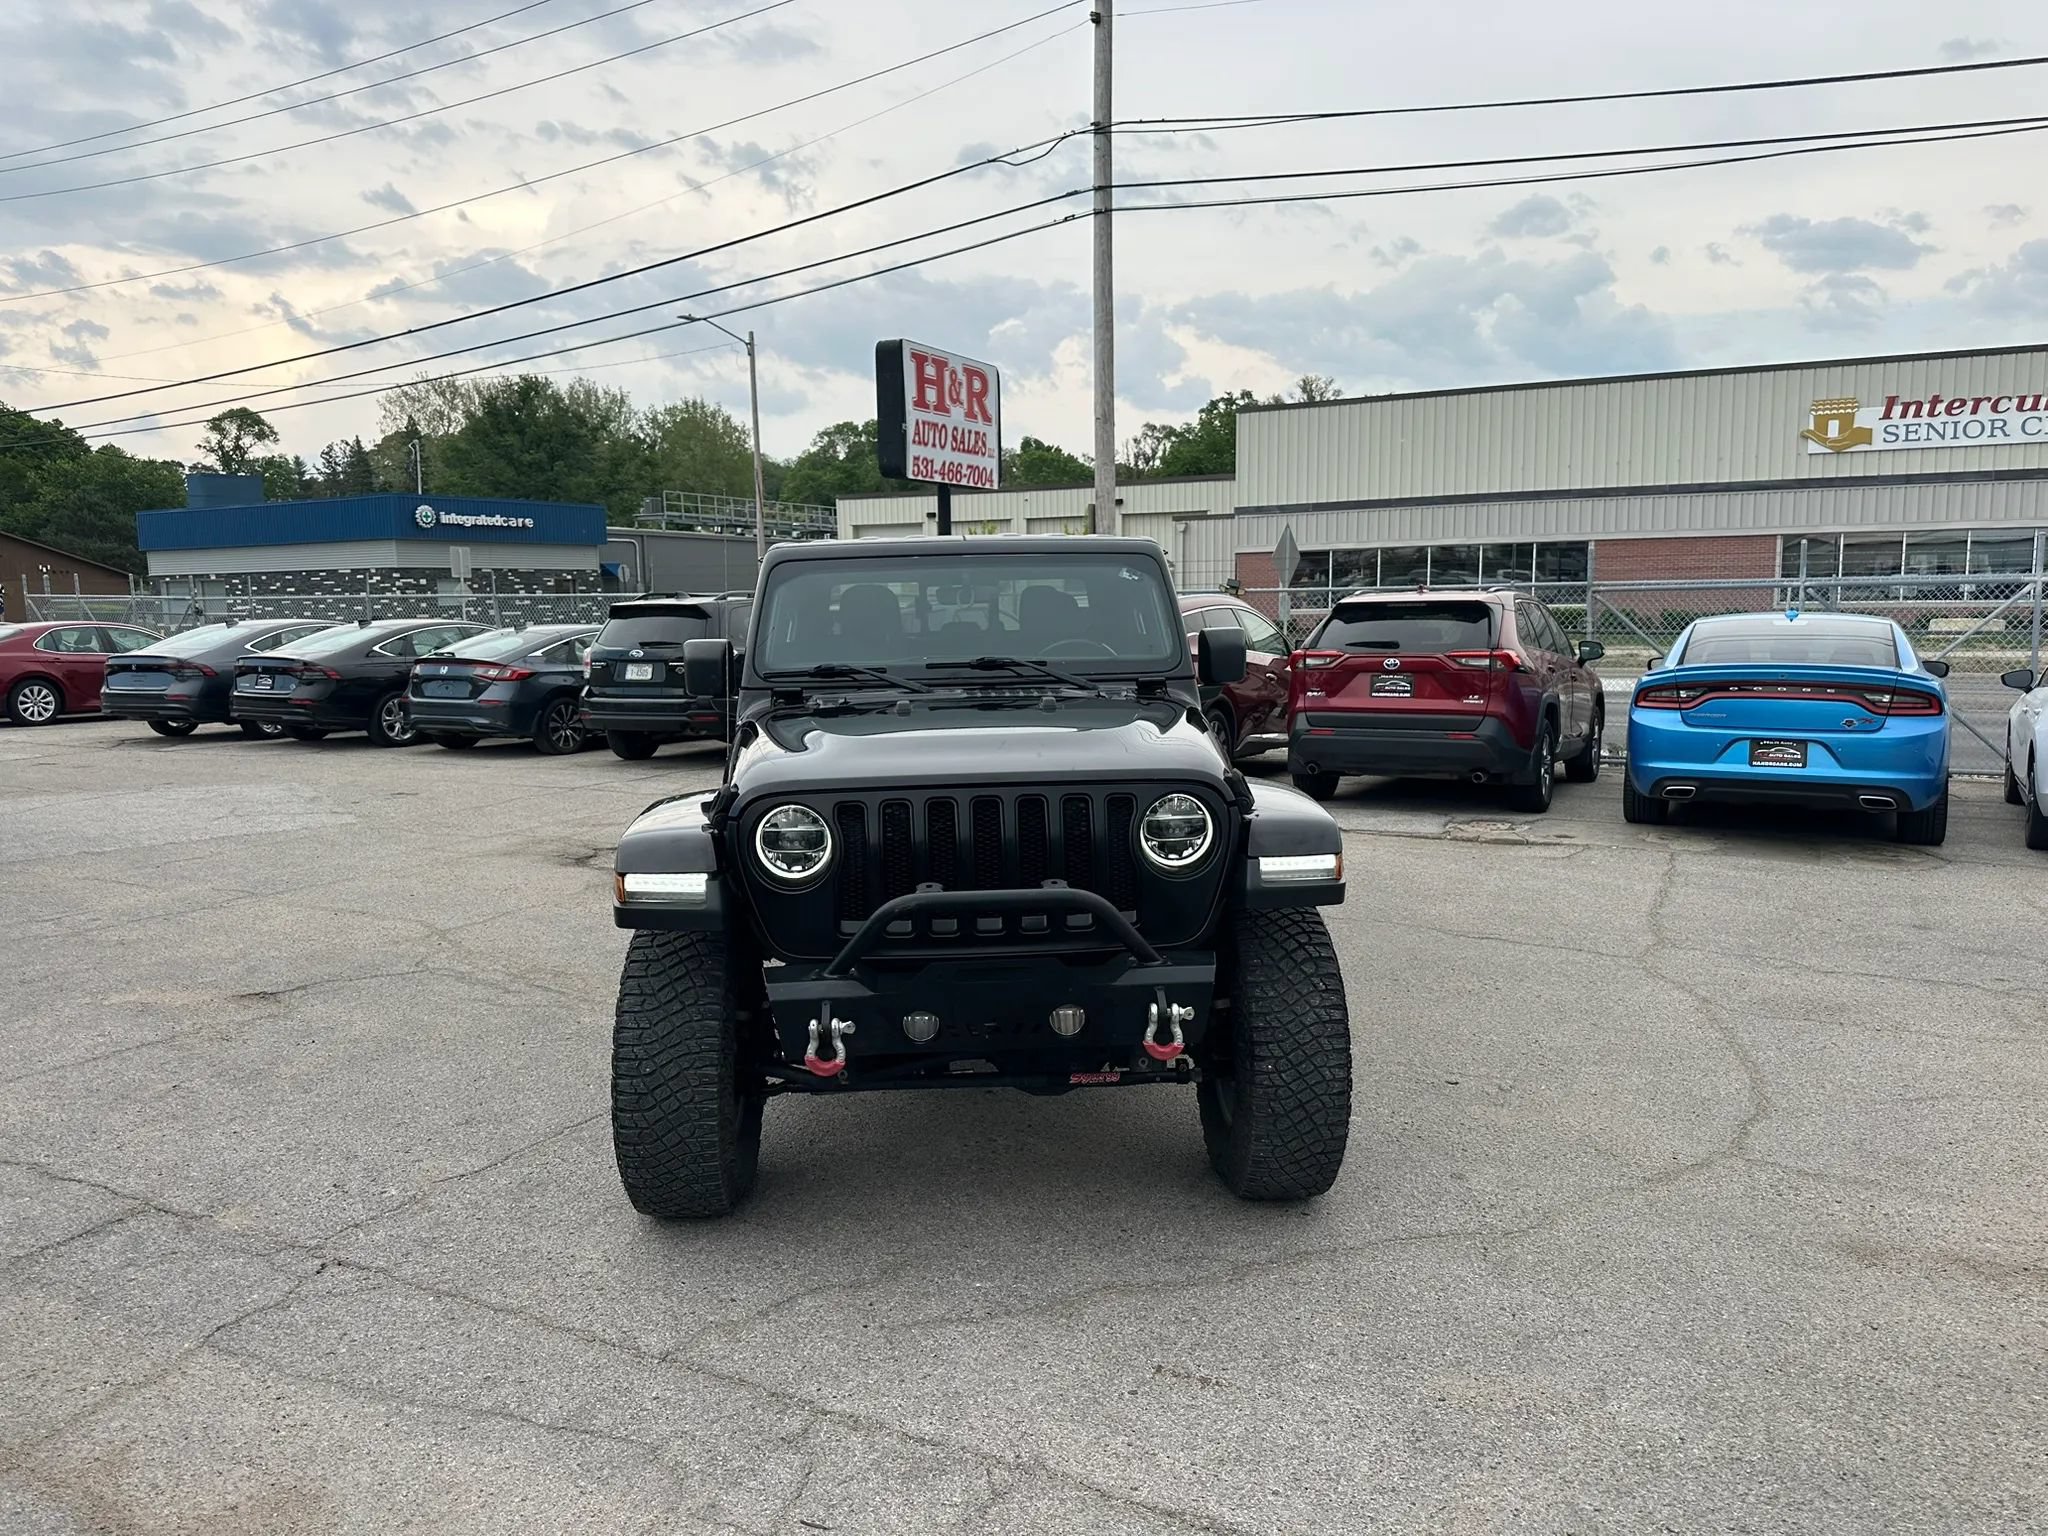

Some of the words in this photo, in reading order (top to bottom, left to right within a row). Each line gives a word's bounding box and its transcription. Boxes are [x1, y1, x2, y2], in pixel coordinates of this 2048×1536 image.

[910, 348, 992, 426] H&R
[912, 419, 947, 449] AUTO
[951, 426, 987, 458] SALES
[1882, 418, 2010, 443] SENIOR
[2020, 416, 2048, 436] C
[912, 454, 993, 487] 531-466-7004
[439, 511, 534, 528] integratedcare
